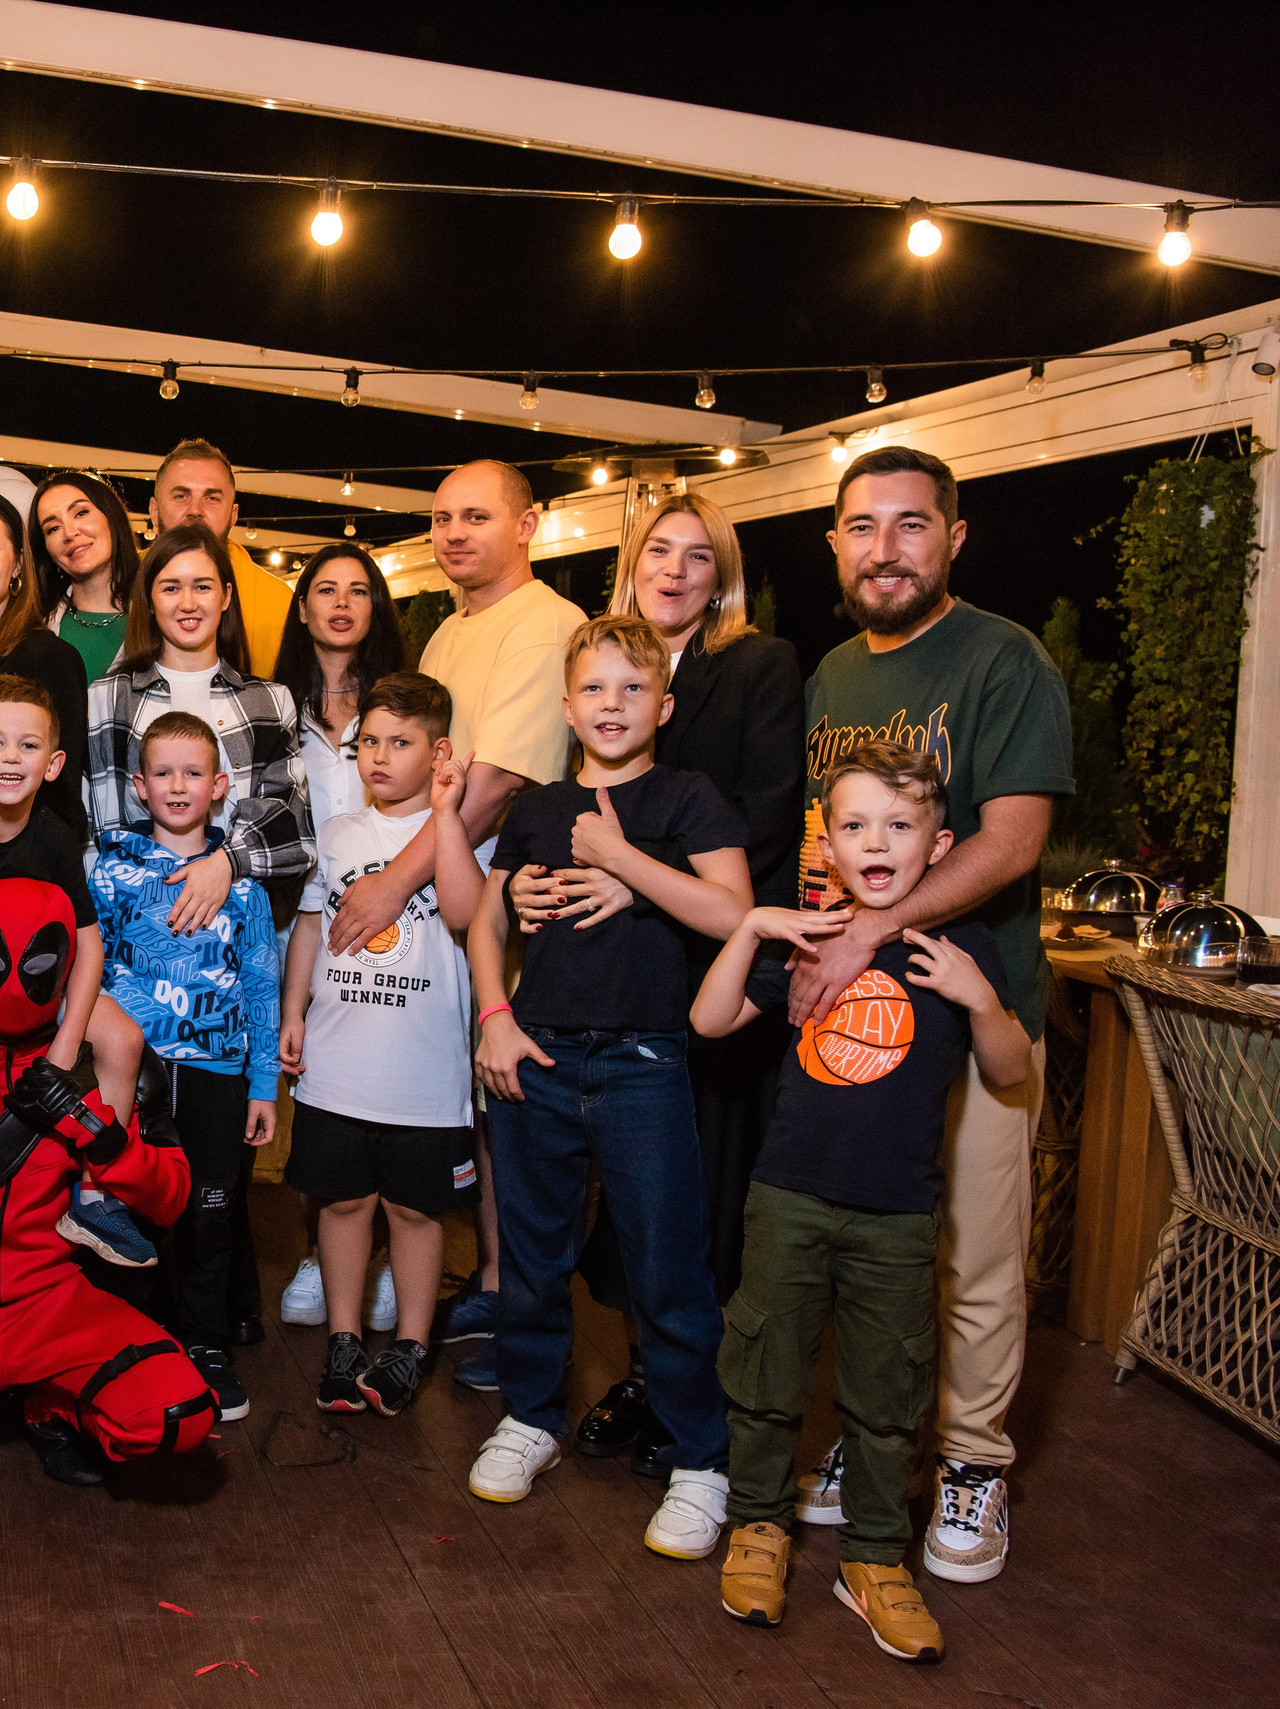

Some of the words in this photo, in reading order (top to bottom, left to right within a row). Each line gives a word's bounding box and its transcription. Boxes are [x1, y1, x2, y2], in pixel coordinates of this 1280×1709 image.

[326, 968, 362, 985] FOUR
[374, 973, 431, 992] GROUP
[835, 970, 895, 1004] ASS
[154, 980, 189, 1017] DO
[340, 989, 406, 1008] WINNER
[832, 1000, 906, 1046] PLAY
